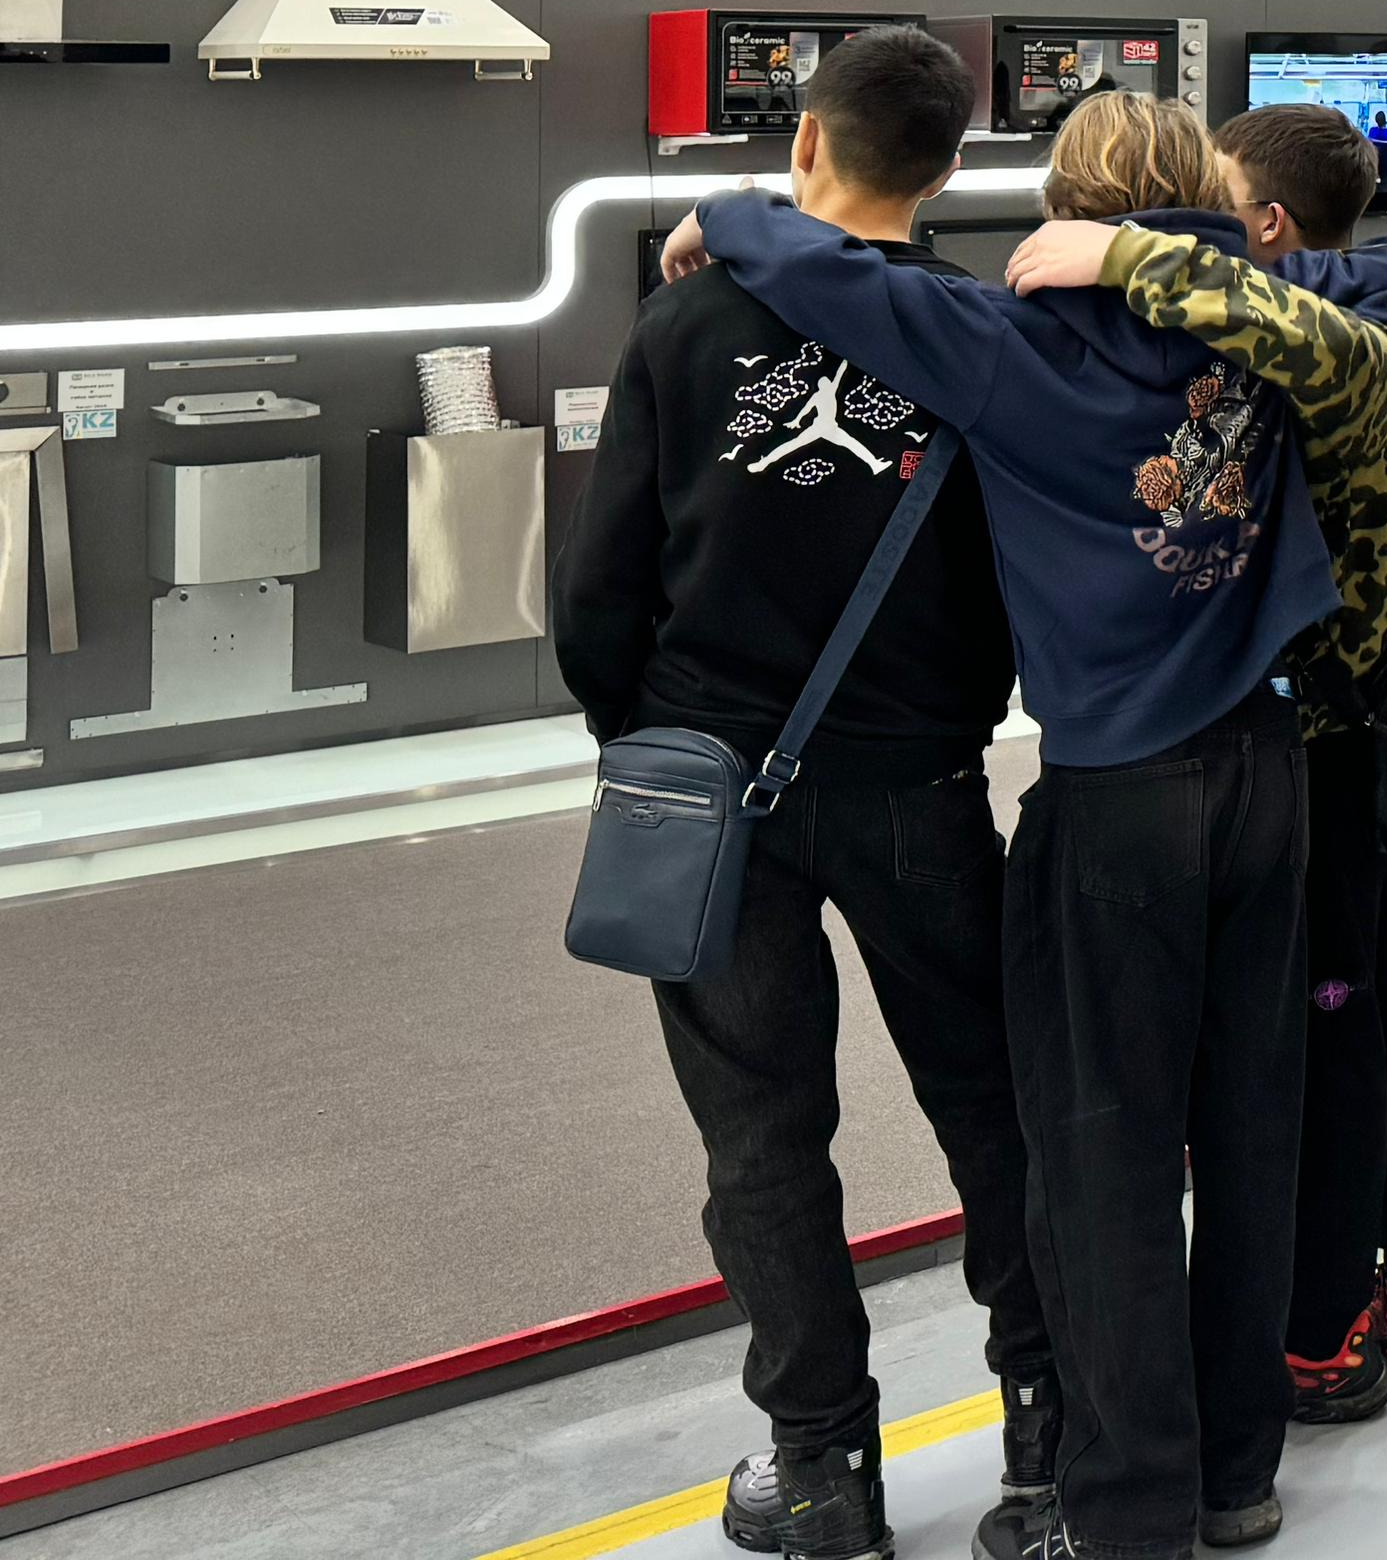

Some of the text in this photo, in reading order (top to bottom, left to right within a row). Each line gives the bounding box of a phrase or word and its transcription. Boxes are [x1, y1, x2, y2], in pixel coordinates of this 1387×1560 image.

[729, 35, 786, 45] Bio ceramic
[1024, 44, 1074, 53] Bio ceramic
[770, 70, 793, 85] 99
[1059, 76, 1080, 89] 99
[82, 411, 115, 429] KZ
[572, 426, 599, 442] KZ
